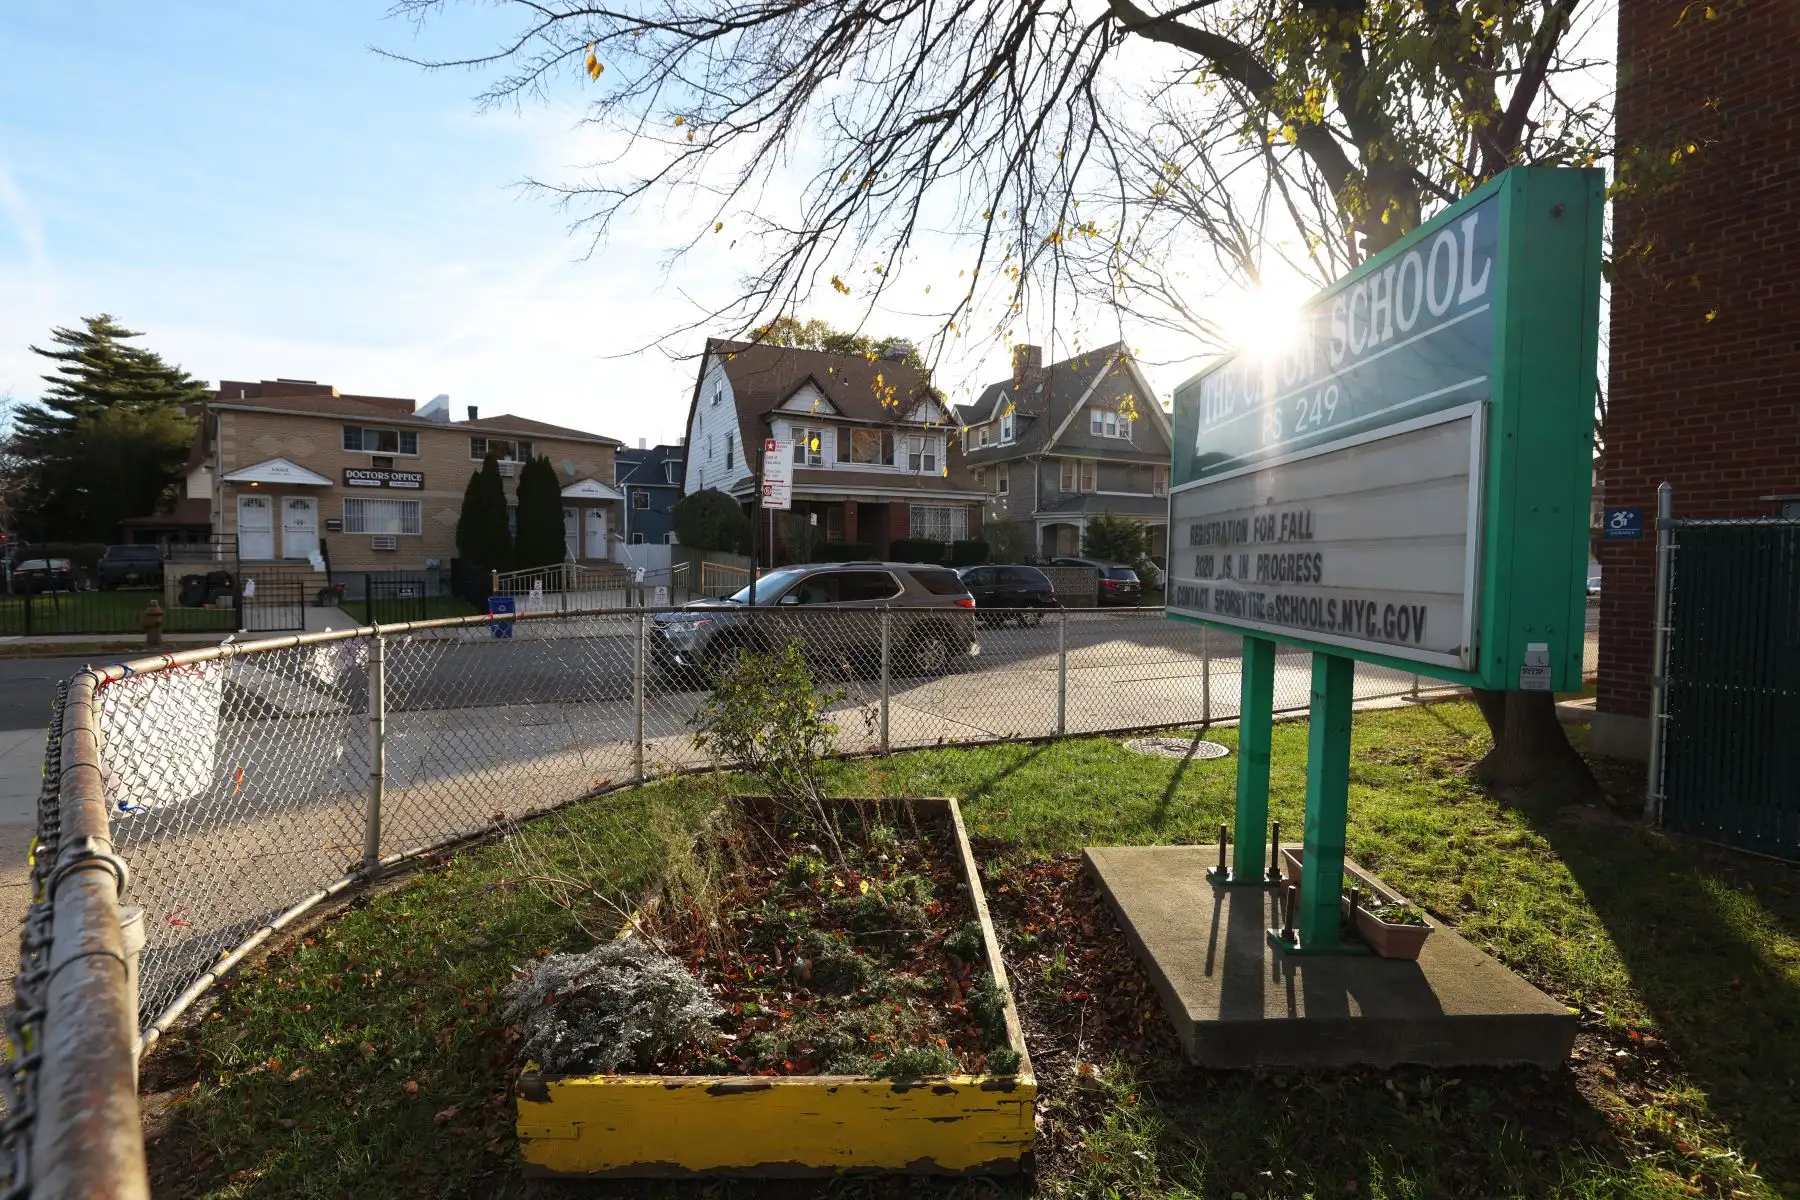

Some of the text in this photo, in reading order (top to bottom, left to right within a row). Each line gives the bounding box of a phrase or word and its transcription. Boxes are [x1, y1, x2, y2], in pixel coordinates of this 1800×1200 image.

[1204, 371, 1236, 426] THE
[1330, 213, 1491, 366] SCHOOL
[1262, 385, 1339, 446] PS 249
[346, 470, 422, 482] DOCTORS OFFICE
[1190, 511, 1313, 546] REGISTRATION FOR FALL
[1195, 552, 1322, 584] 2020 IS IN PROGRESS
[1176, 585, 1209, 609] CONTACT
